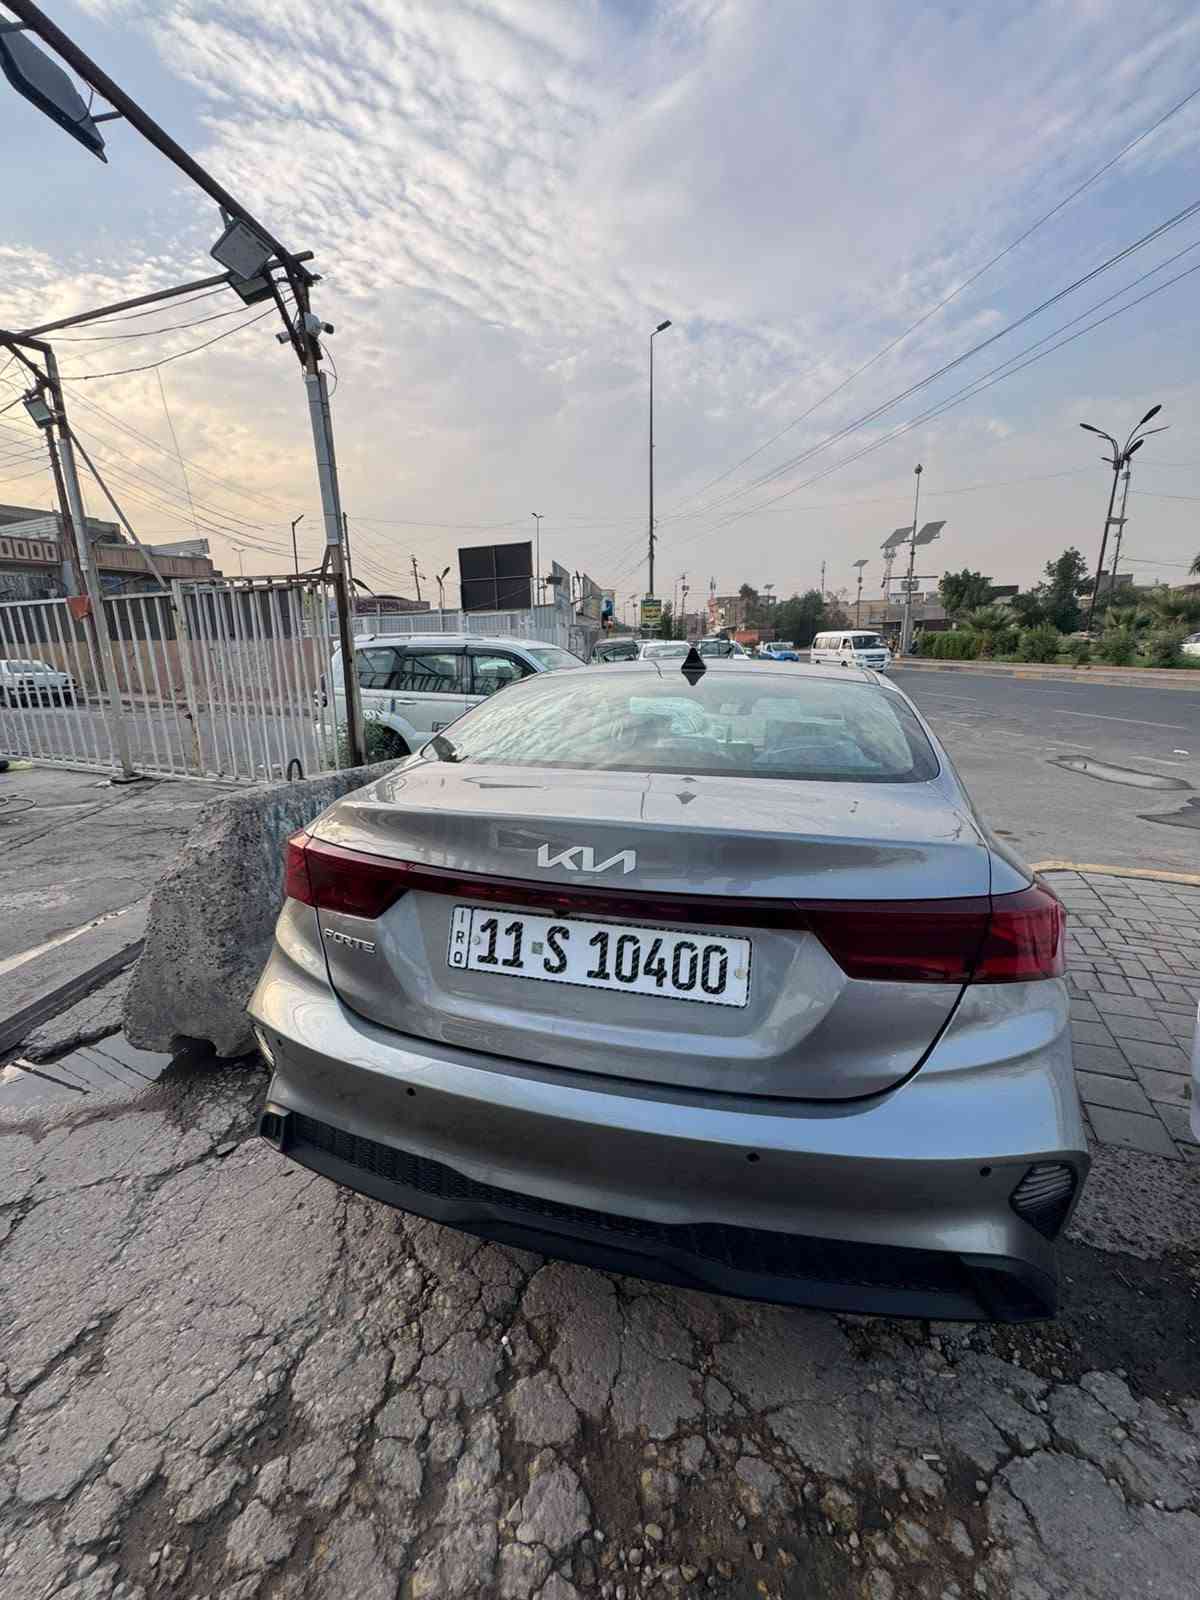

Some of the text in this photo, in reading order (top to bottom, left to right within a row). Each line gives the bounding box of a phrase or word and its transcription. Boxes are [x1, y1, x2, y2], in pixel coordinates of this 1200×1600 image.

[537, 843, 636, 874] KIA
[323, 928, 376, 953] FORTE
[454, 910, 465, 964] IRQ
[477, 918, 728, 995] 11 S 10400
